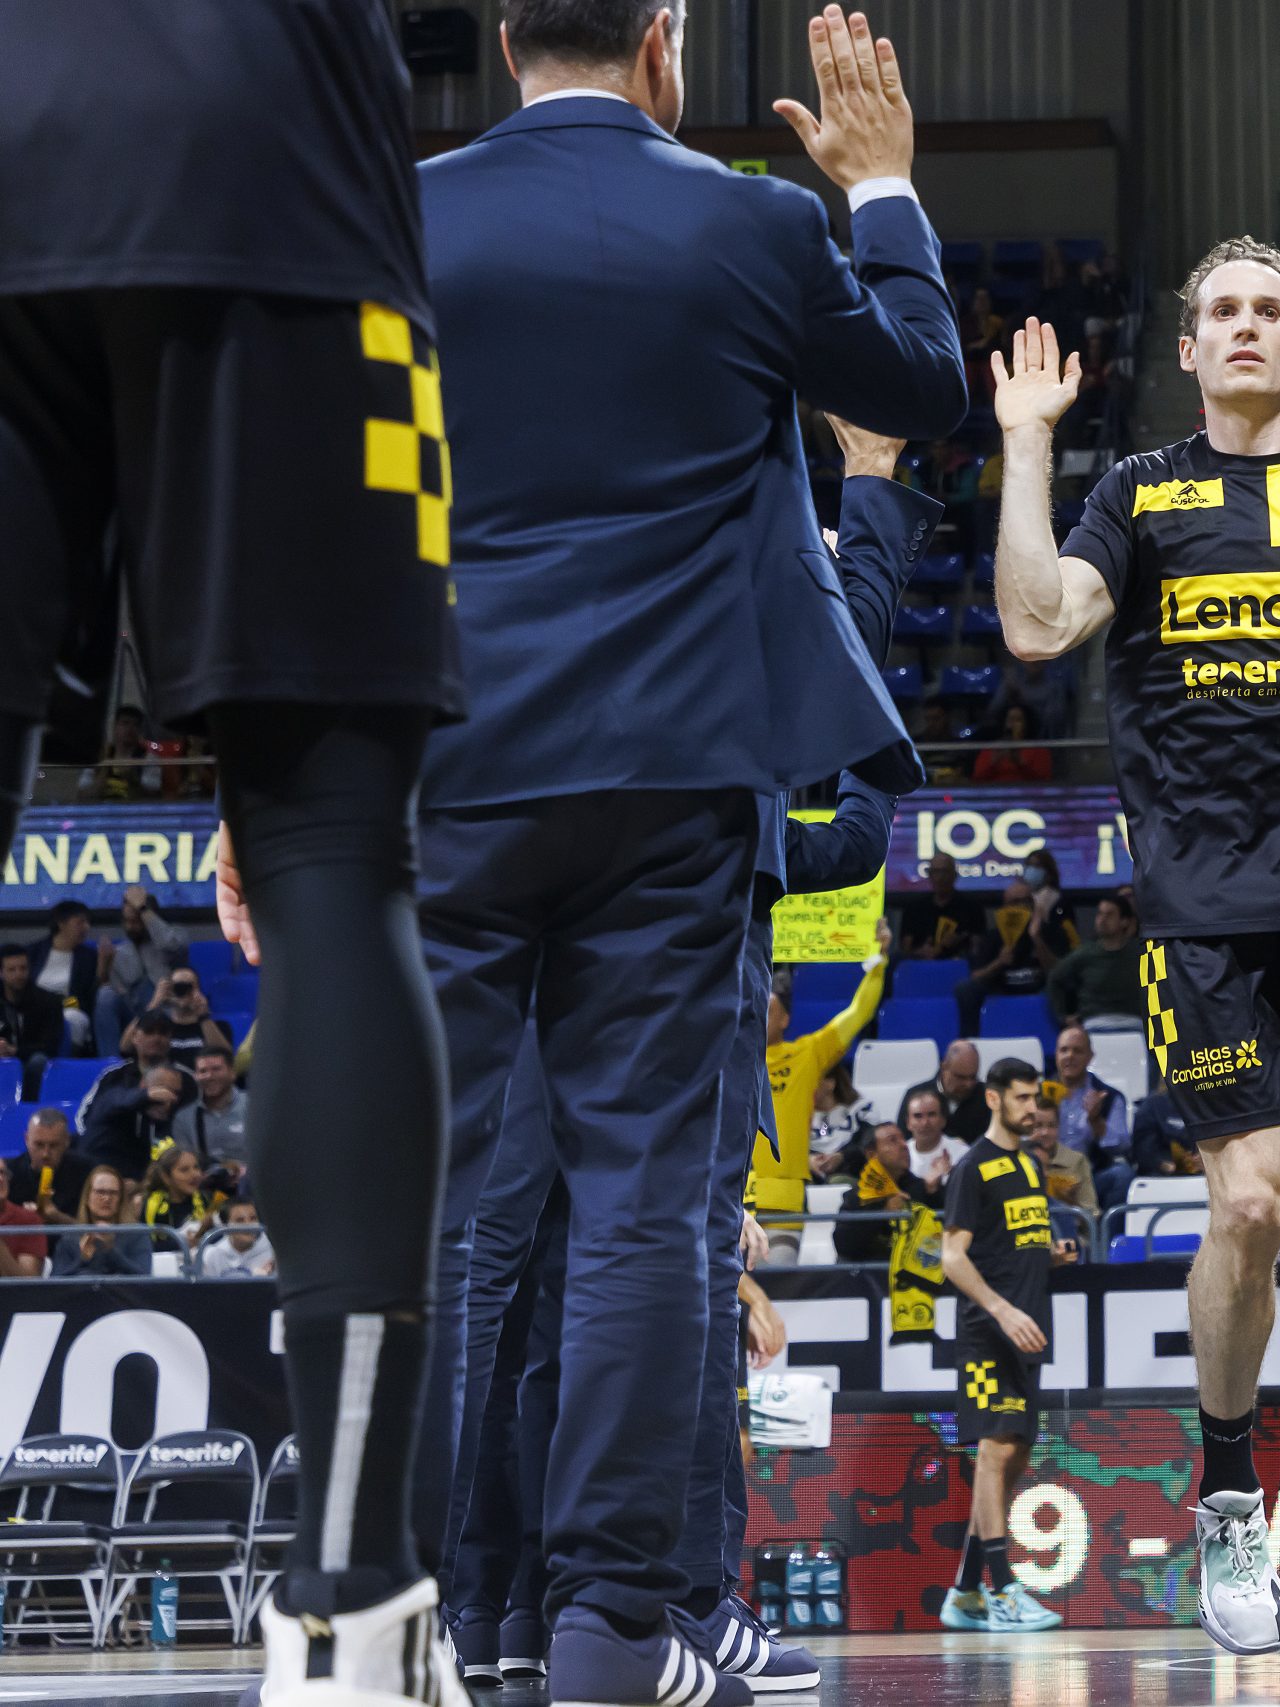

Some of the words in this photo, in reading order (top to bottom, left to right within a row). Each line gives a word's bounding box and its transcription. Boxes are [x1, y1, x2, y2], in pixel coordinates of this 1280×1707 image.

[1187, 686, 1250, 700] despierta
[917, 809, 1046, 860] IOC
[1191, 1046, 1232, 1065] Islas
[1172, 1060, 1234, 1085] Canarias
[1007, 1483, 1089, 1595] 9
